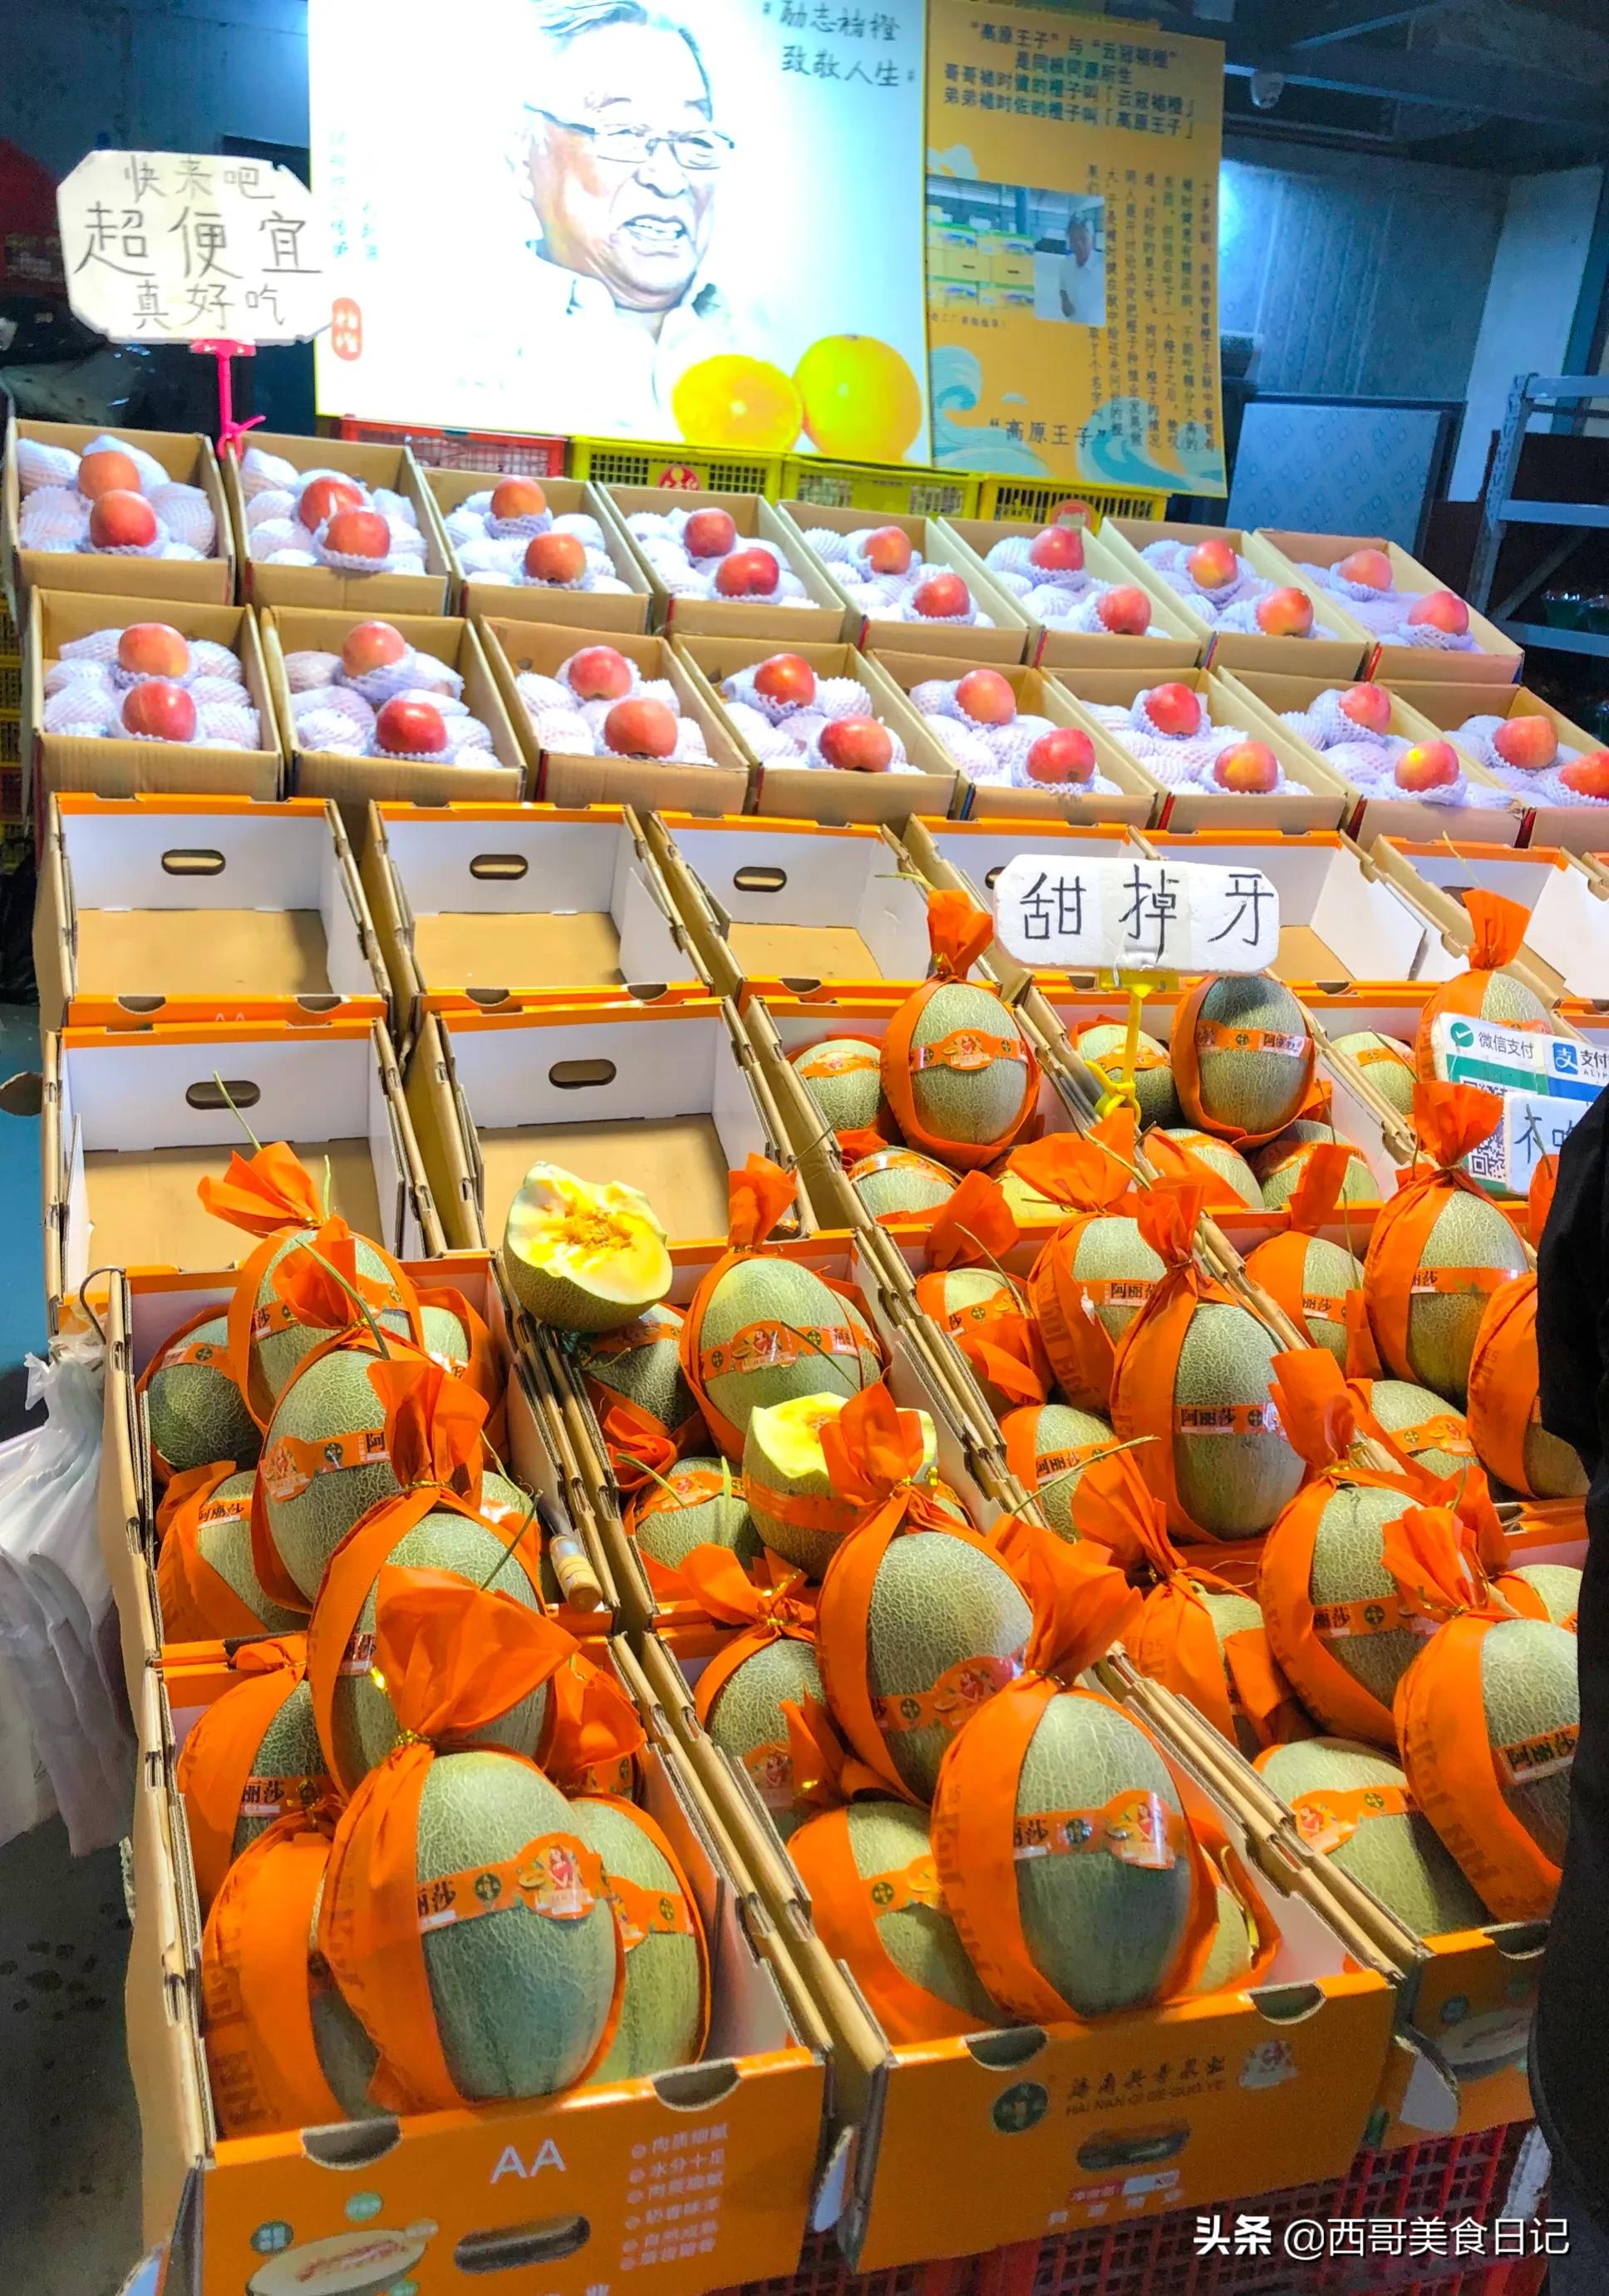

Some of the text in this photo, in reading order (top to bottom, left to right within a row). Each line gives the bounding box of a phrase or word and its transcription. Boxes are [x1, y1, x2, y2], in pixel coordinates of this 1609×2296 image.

[125, 155, 275, 204] 快来吧
[74, 201, 323, 279] 超便宜
[133, 279, 286, 332] 真好吃
[1019, 864, 1275, 964] 甜掉牙
[1479, 1032, 1534, 1060] 微信支付
[490, 2138, 567, 2184] AA
